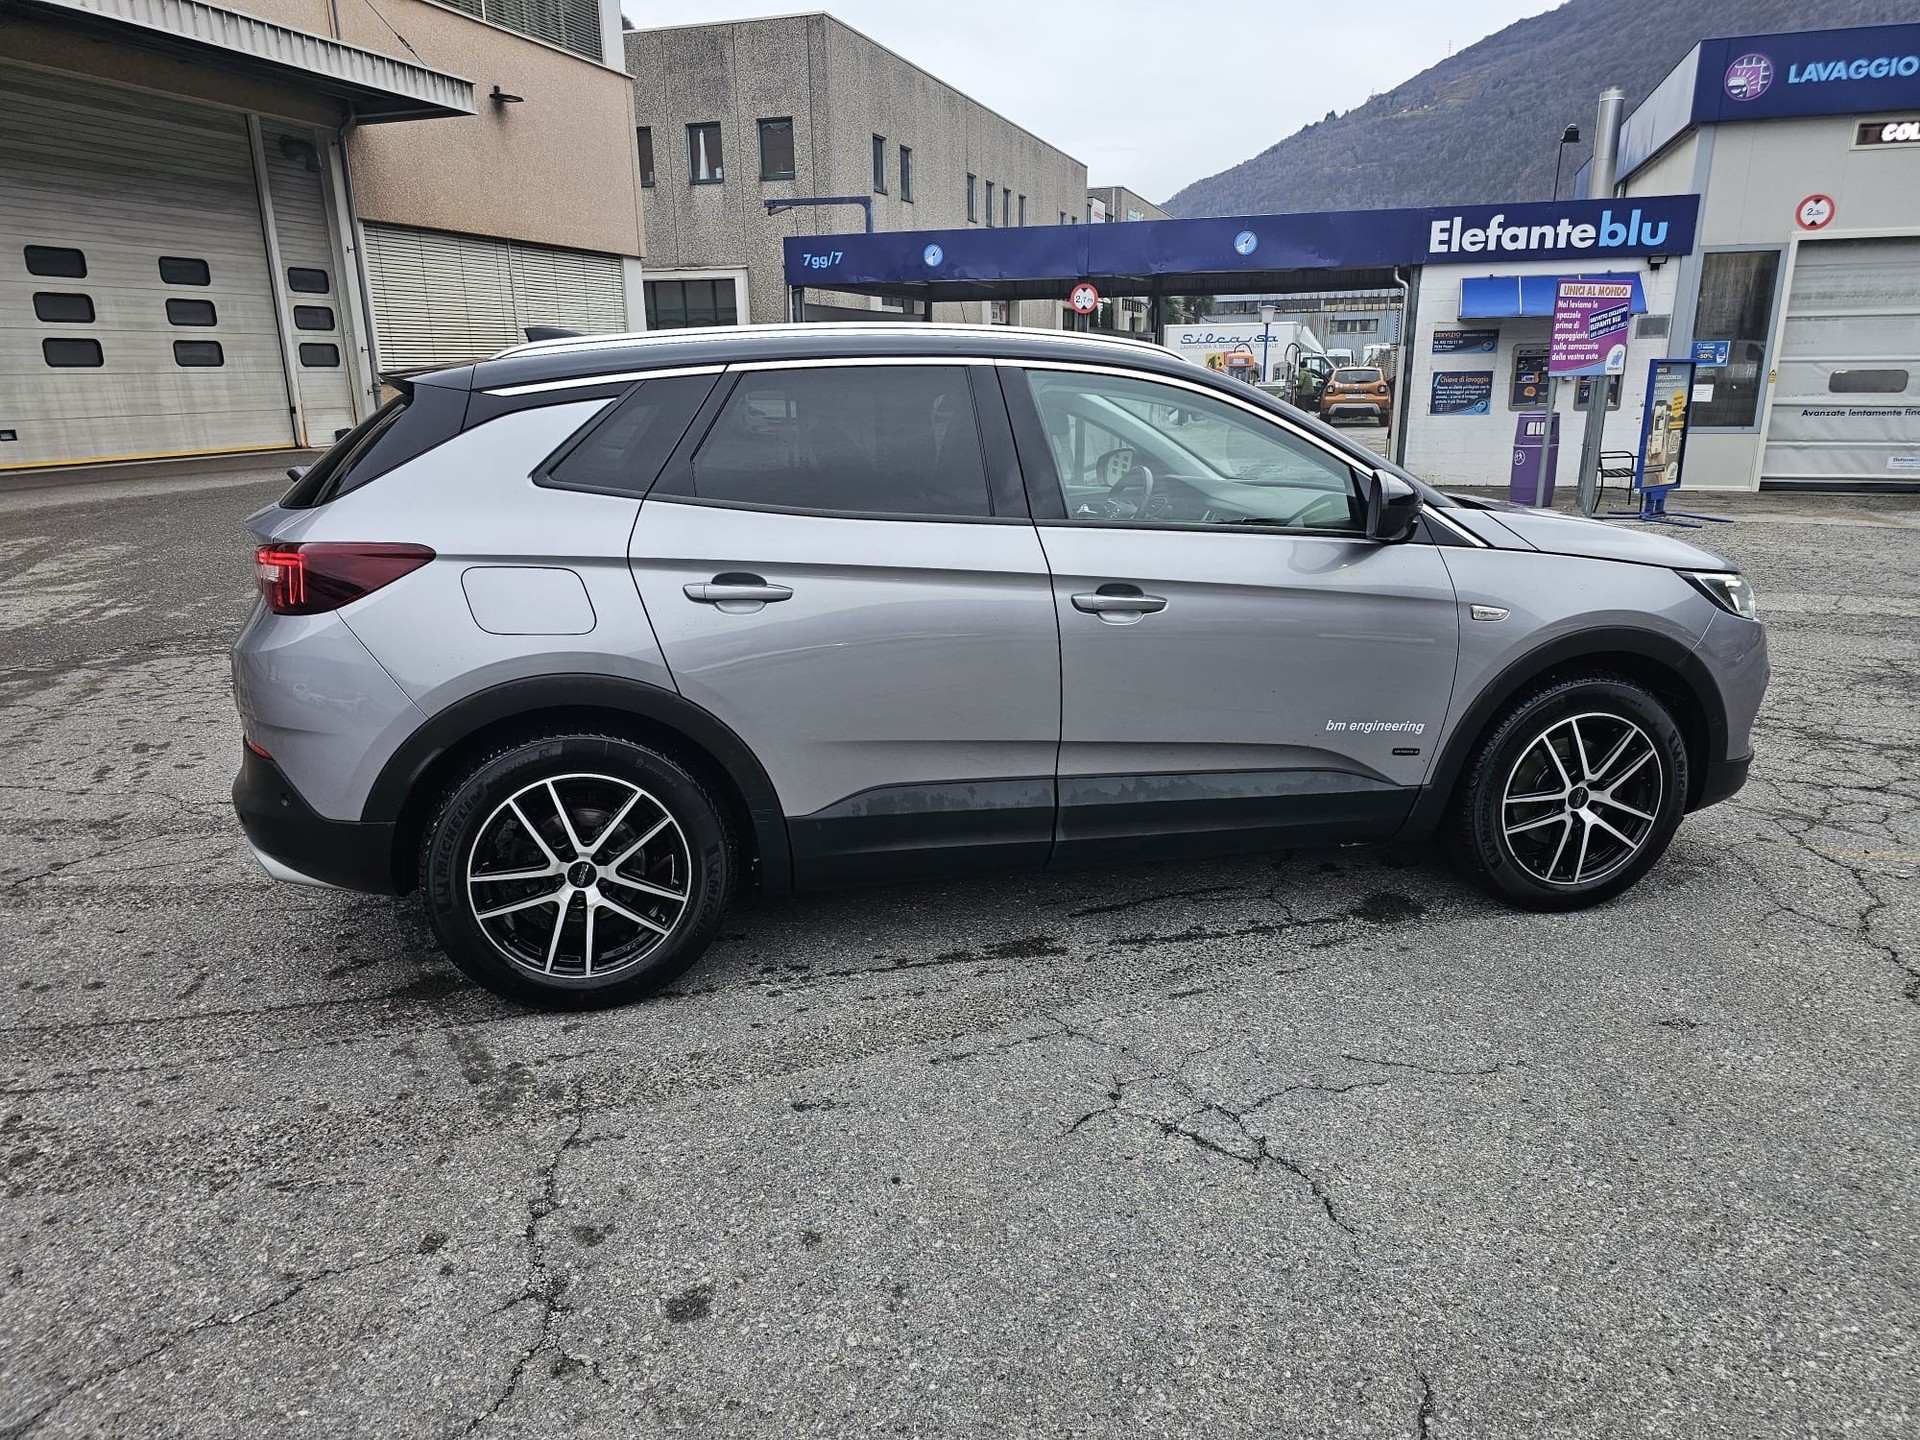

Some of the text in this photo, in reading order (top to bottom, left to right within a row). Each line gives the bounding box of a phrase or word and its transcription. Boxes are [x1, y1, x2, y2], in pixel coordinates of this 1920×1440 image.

[1788, 55, 1919, 83] LAVAGGIO
[803, 251, 843, 269] 7gg/7
[1564, 285, 1628, 297] UNICI AL MONDO
[1569, 300, 1592, 309] laviamo
[1592, 300, 1598, 309] le
[1556, 311, 1581, 320] spazzole
[1555, 321, 1571, 331] prima
[1554, 331, 1588, 341] appoggiarle
[1553, 342, 1599, 350] sulla carrozzeria
[1551, 352, 1566, 361] della
[1440, 375, 1458, 383] Chiave
[1465, 375, 1489, 384] lavaggio
[1801, 409, 1846, 417] Avanzate
[1848, 408, 1902, 417] lentamente
[1325, 719, 1425, 735] bm engineering
